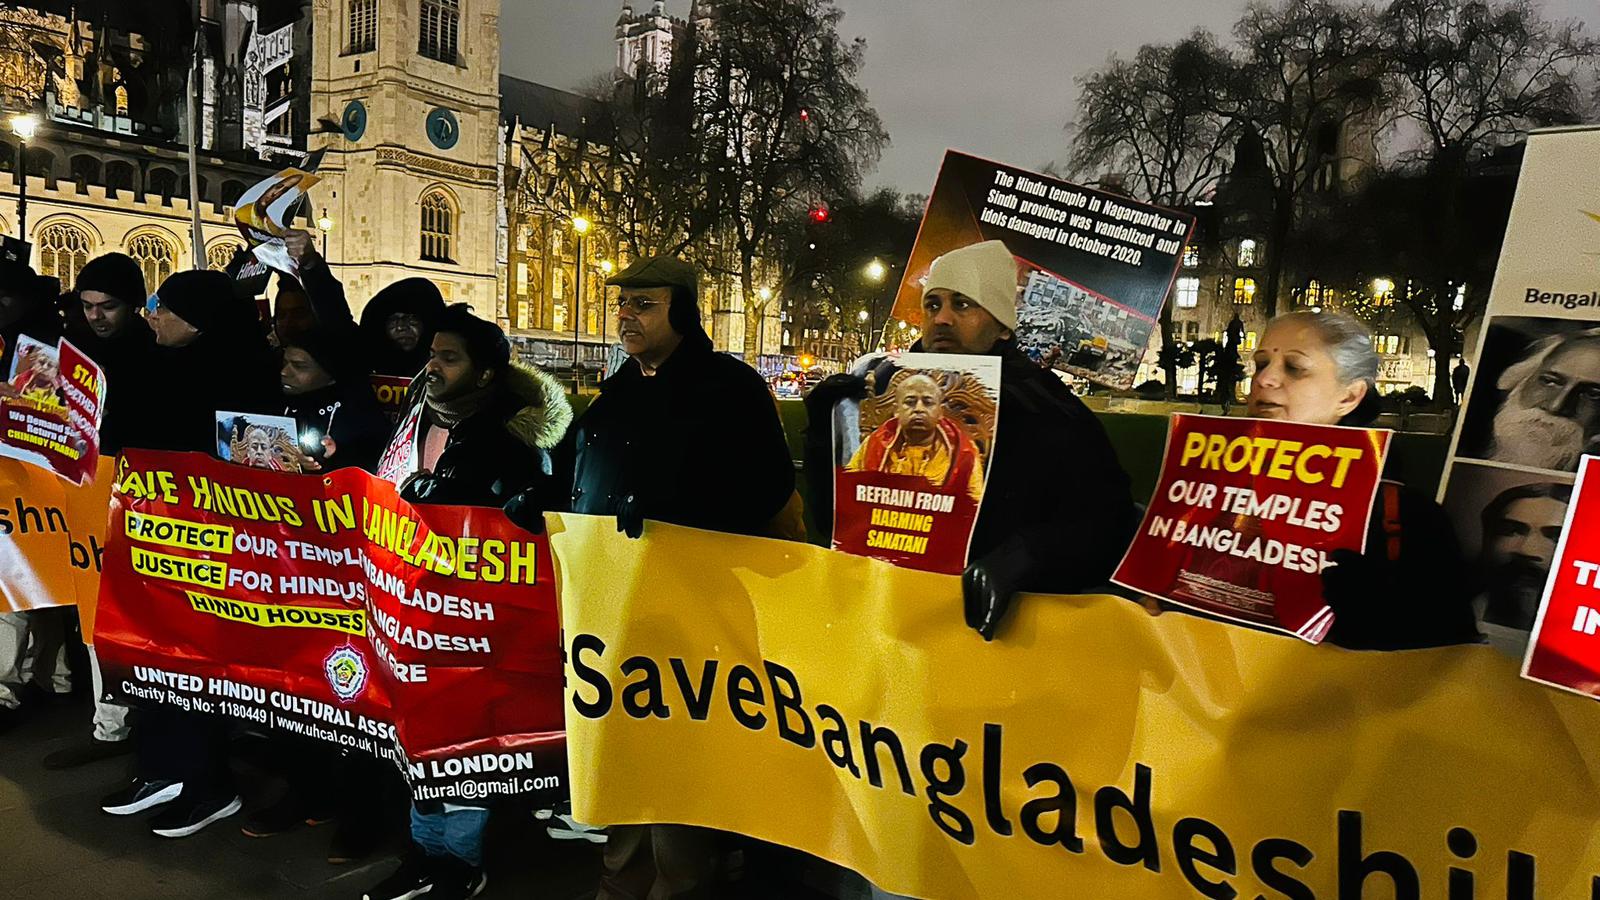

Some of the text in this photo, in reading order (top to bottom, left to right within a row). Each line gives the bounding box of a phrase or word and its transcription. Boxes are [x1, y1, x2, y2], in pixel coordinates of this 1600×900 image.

[987, 188, 1180, 256] Sindh province was vandalized and
[994, 170, 1187, 236] The Hindu temple in Nagarparkar in
[980, 207, 1142, 267] idols damaged in October 2020.
[1524, 288, 1600, 309] Bengal
[9, 410, 25, 423] We
[27, 414, 63, 434] Demand
[371, 384, 408, 405] OT
[27, 424, 67, 443] Return of
[1180, 431, 1364, 488] PROTECT
[187, 475, 303, 527] HNDUS
[312, 493, 357, 534] IN
[856, 484, 955, 513] REFRAIN FROM
[870, 508, 934, 533] HARMING
[1148, 515, 1173, 538] IN
[1167, 479, 1344, 532] OUR TEMPLES
[128, 515, 230, 550] PROTECT
[235, 532, 278, 560] OUR
[284, 540, 359, 568] TEMPL
[369, 563, 495, 621] BANGLADESH
[866, 529, 929, 554] SANATANI
[135, 553, 223, 585] JUSTICE
[228, 568, 273, 594] FOR
[279, 575, 365, 602] HINDUS
[371, 600, 491, 653] ANGLADESH
[192, 594, 260, 623] HINDU
[267, 608, 364, 631] HOUSES
[387, 652, 428, 682] FRE
[122, 681, 165, 703] Charity
[168, 690, 190, 712] Reg
[192, 697, 215, 714] No:
[219, 701, 267, 723] 1180449
[276, 715, 372, 753] www.uhcal.co.uk
[133, 666, 204, 693] UNITED
[208, 678, 266, 705] HINDU
[270, 691, 355, 728] CULTURAL
[432, 751, 533, 779] LONDON
[561, 628, 1600, 900] SaveBangladeshi
